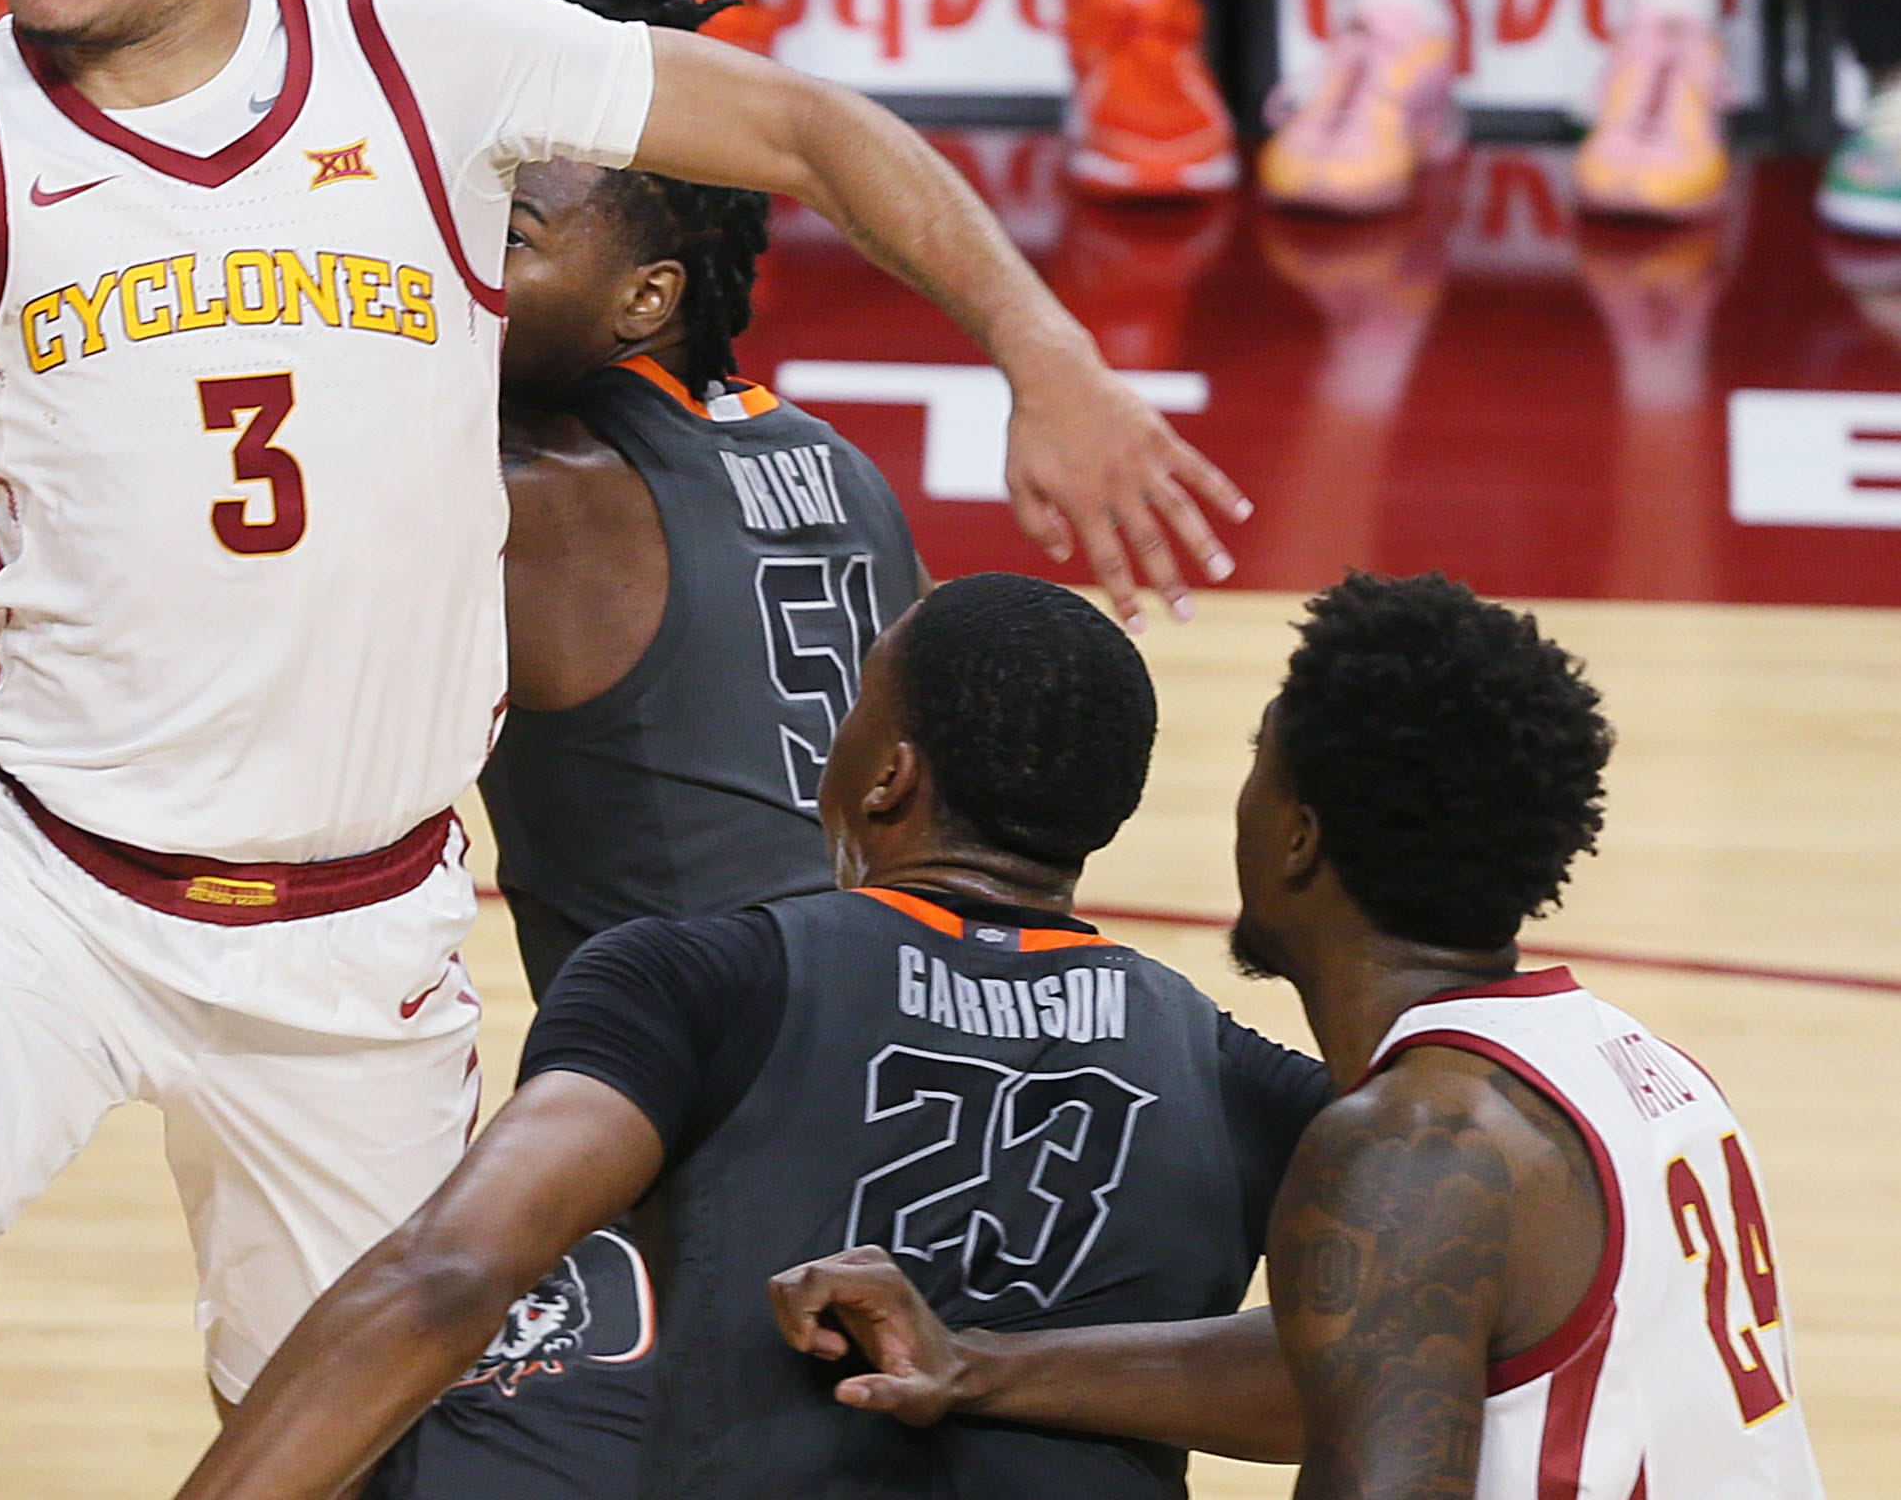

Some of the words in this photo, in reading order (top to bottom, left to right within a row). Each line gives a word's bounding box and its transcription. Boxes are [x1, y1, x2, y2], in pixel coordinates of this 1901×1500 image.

[19, 248, 439, 375] CYCLONES
[195, 370, 308, 558] 3
[754, 553, 882, 808] 51
[897, 943, 1127, 1045] GARRISON
[843, 1043, 1161, 1308] 23
[1665, 1129, 1790, 1430] 24
